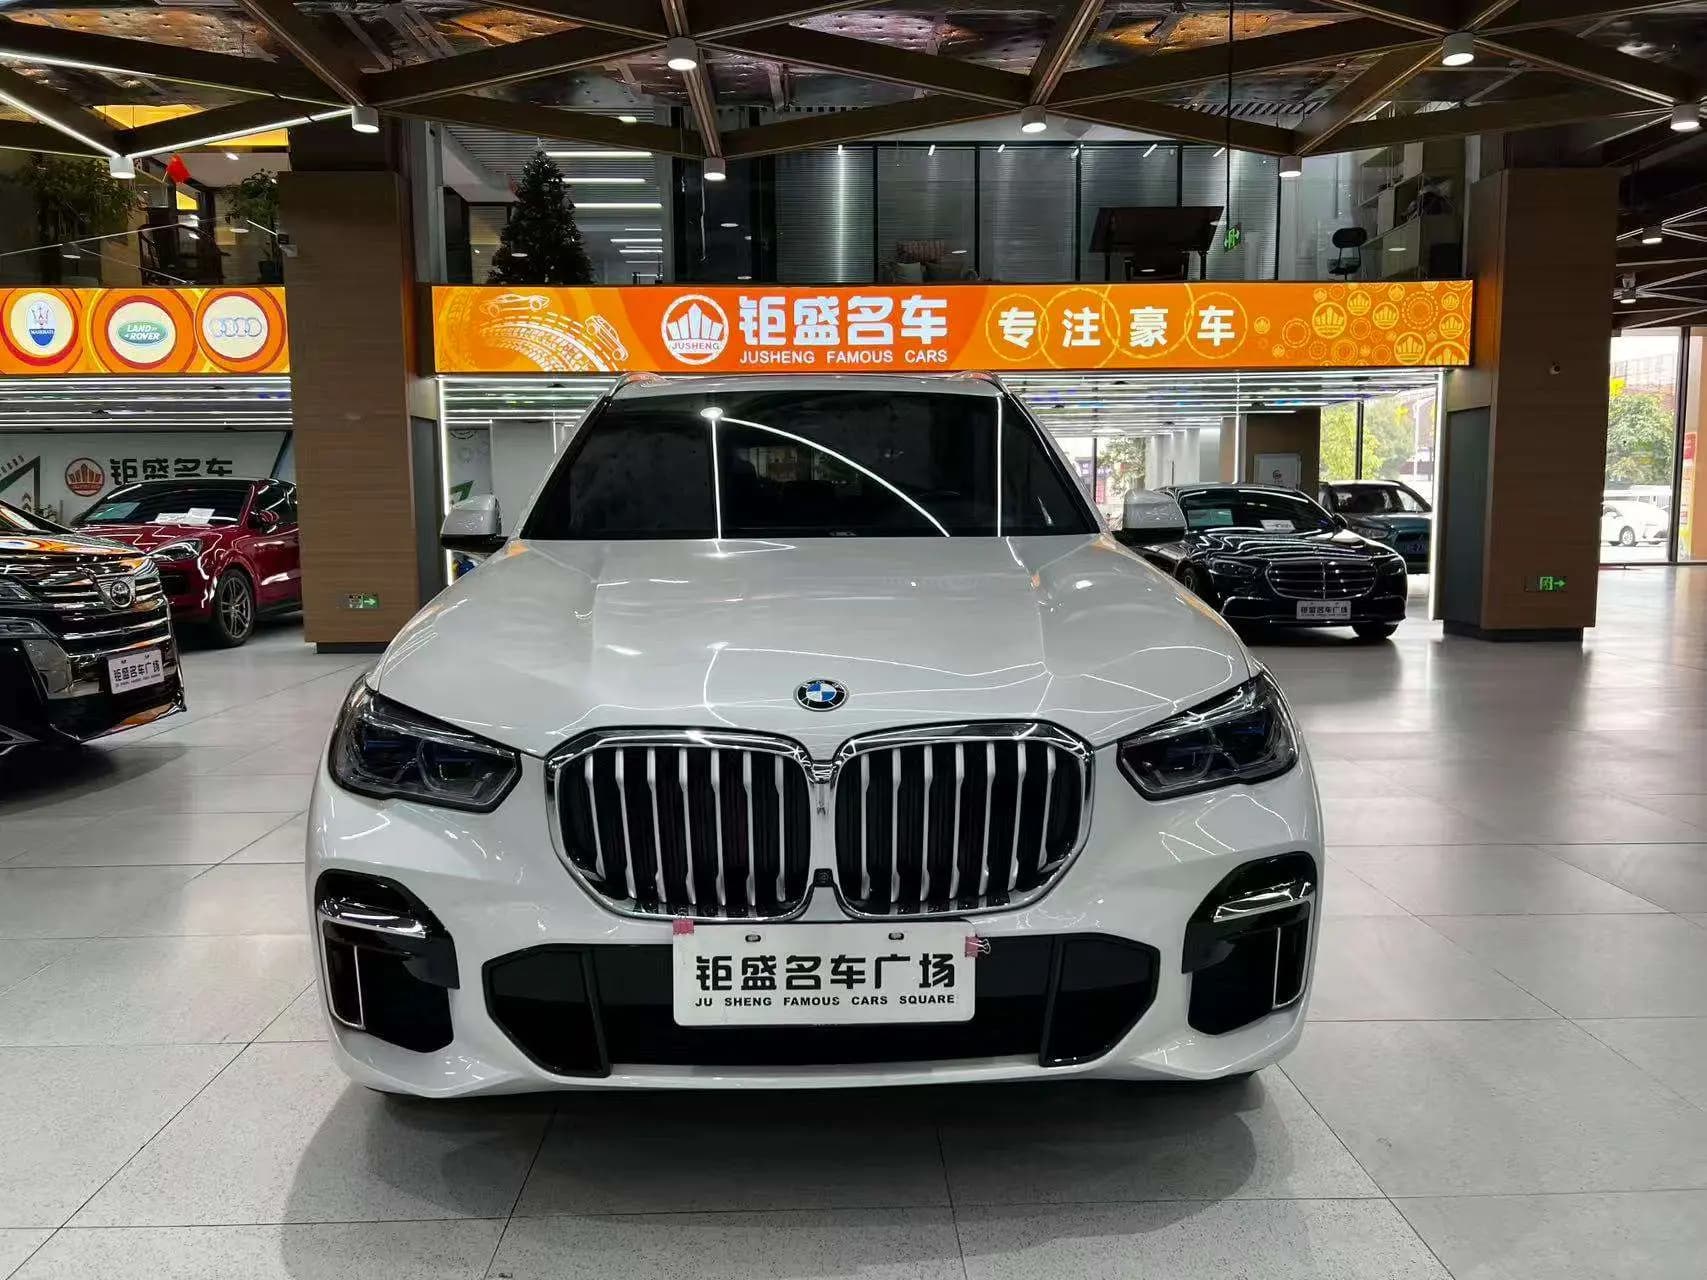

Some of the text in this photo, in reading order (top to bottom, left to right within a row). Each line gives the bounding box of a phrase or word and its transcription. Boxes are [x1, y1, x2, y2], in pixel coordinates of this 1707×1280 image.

[739, 295, 948, 346] 钜盛名车
[998, 305, 1236, 349] 专注豪车
[126, 324, 152, 332] LAND
[130, 332, 160, 340] ROVER
[672, 341, 720, 350] JUSHENG
[739, 349, 948, 364] JUSHENG FAMOUS CARS
[695, 953, 956, 991] 钜盛名车广场
[695, 994, 955, 1007] JU SHENG FAMOUS CARS SQUARE
